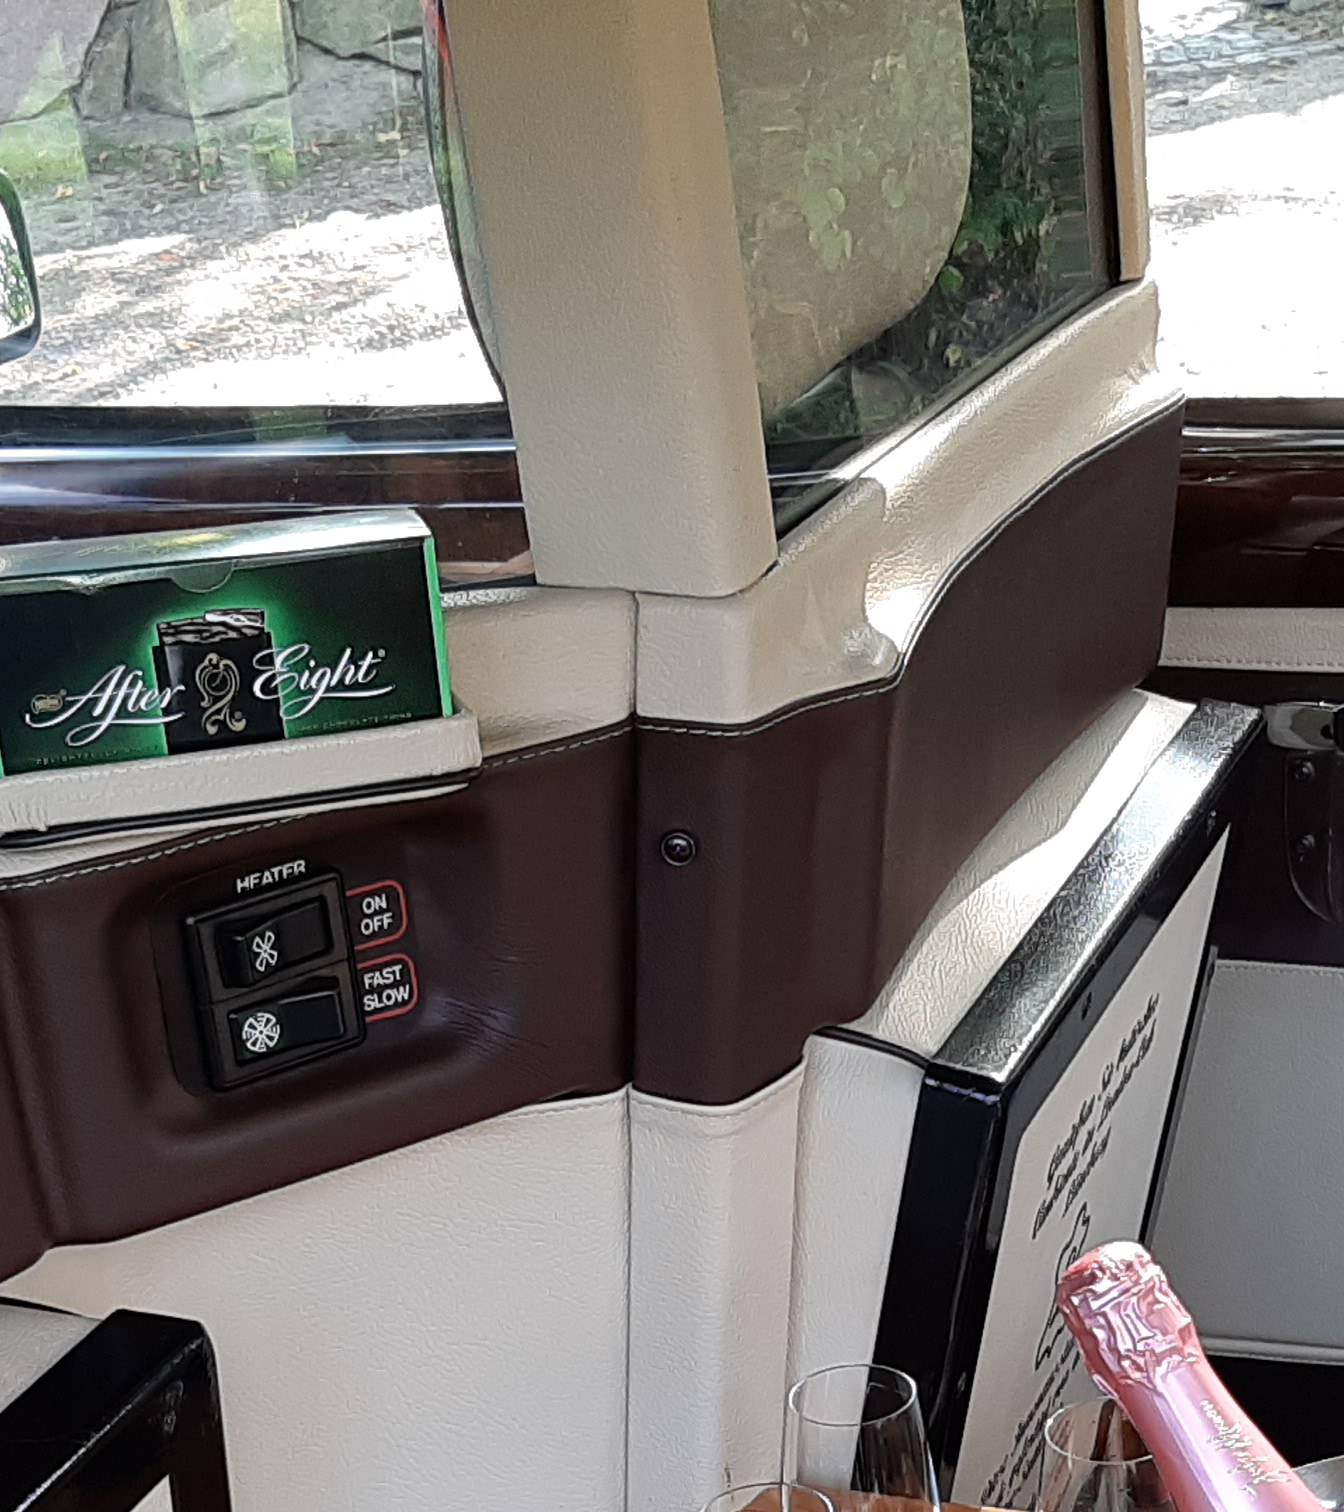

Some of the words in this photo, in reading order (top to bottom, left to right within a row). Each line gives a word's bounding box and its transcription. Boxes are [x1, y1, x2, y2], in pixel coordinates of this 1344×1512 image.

[24, 664, 186, 748] After
[254, 643, 396, 719] Eight
[236, 860, 306, 892] HEATER
[363, 895, 387, 913] ON
[361, 913, 393, 935] OFF
[363, 964, 403, 989] FAST
[363, 985, 410, 1012] SLOW
